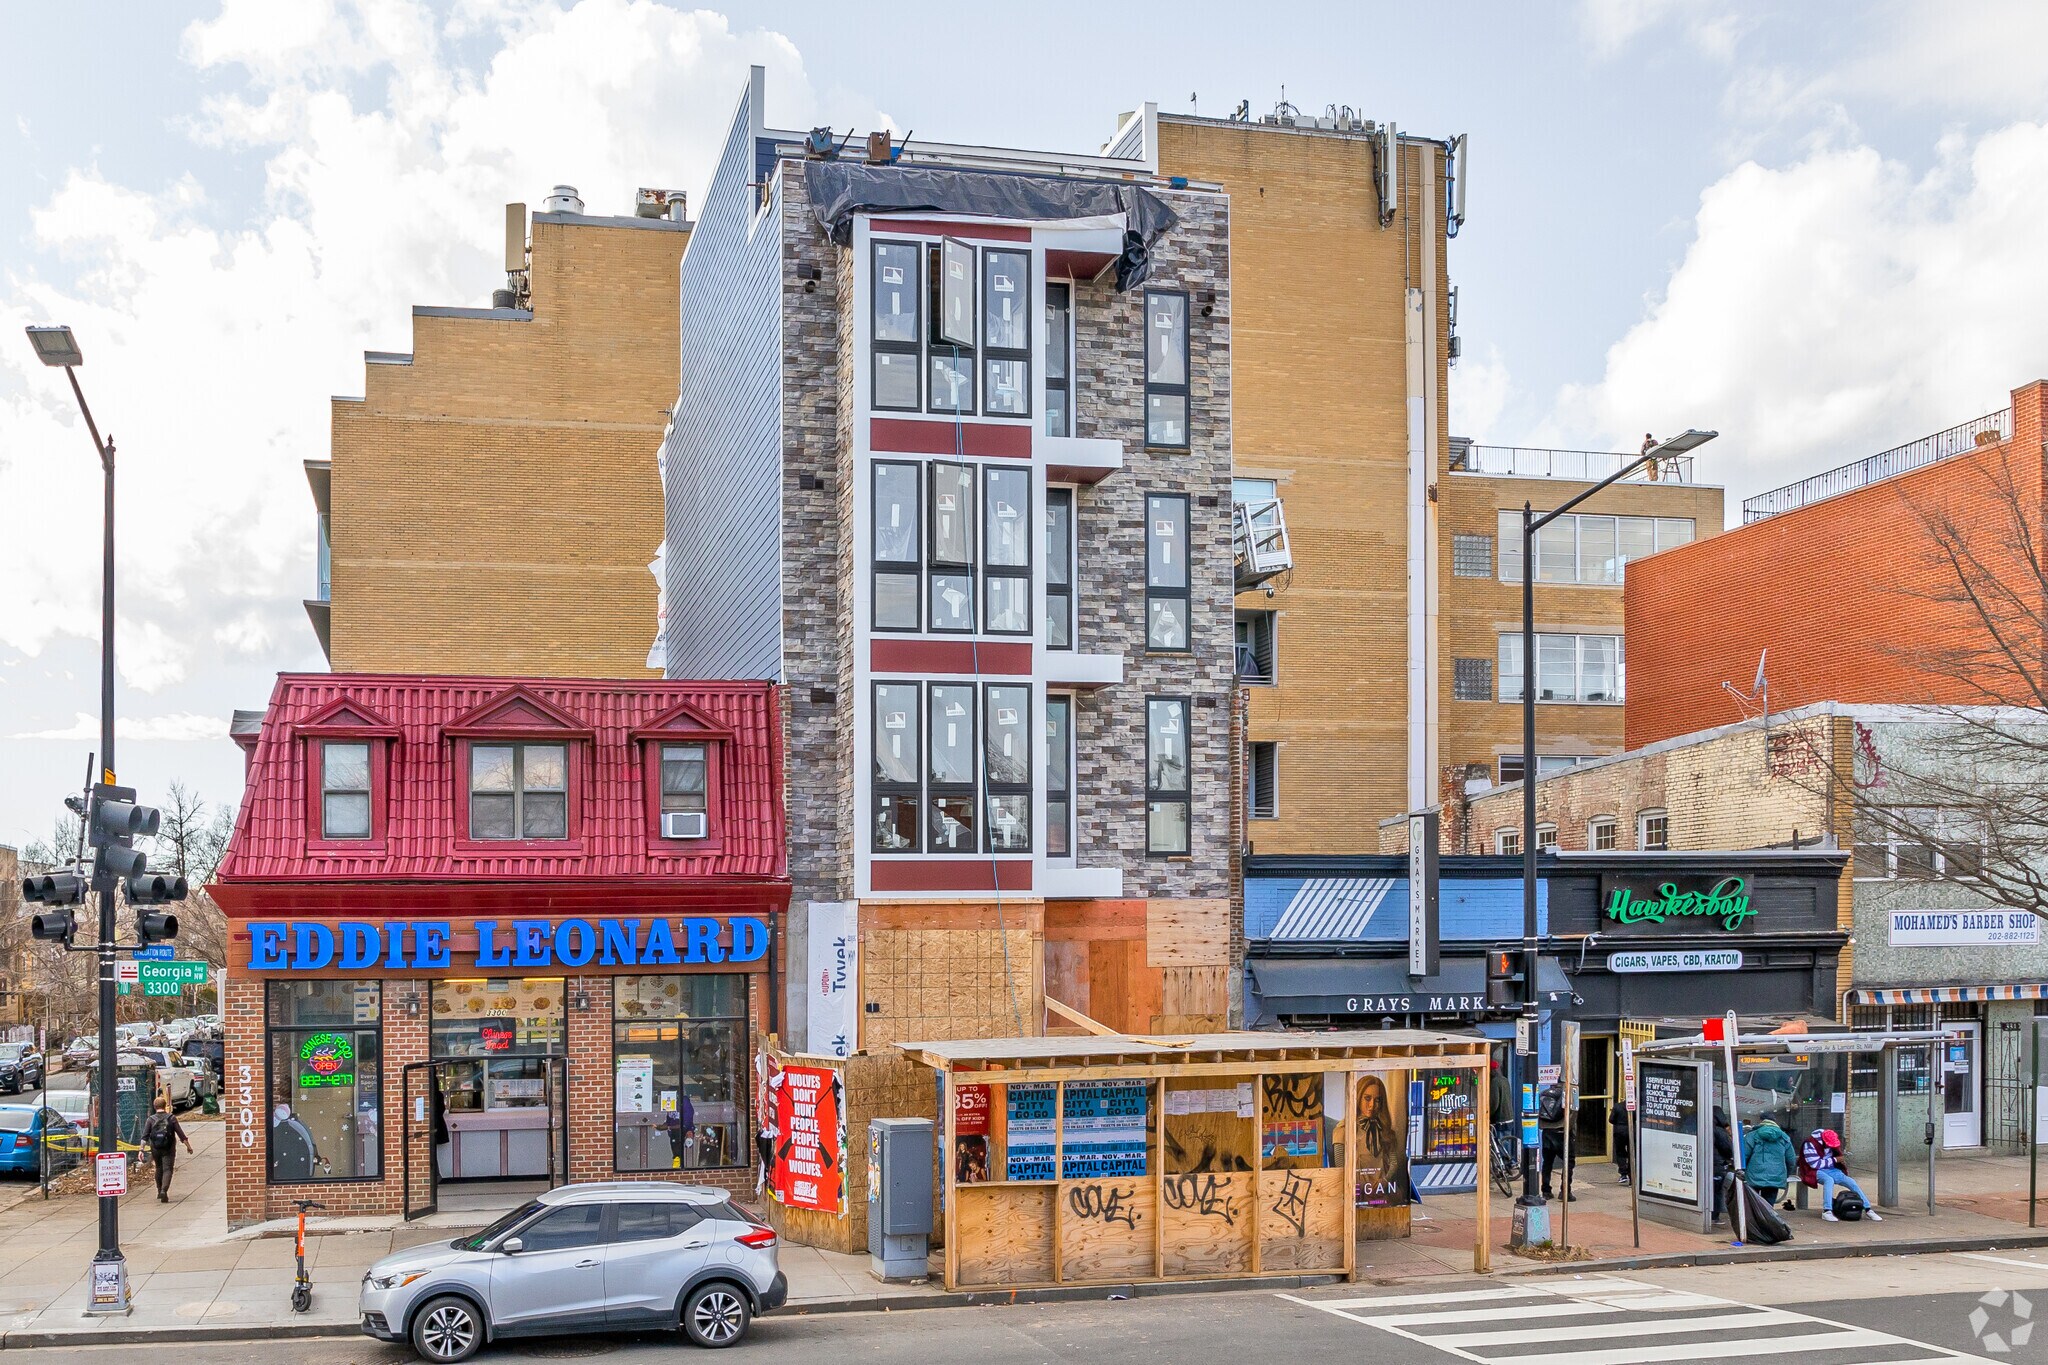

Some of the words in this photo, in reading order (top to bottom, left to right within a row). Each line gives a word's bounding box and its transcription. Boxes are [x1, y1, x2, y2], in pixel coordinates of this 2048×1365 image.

[1608, 876, 1758, 931] Hawkesbay
[1894, 914, 1958, 930] MOHAMED'S
[1962, 914, 2004, 930] BARBER
[247, 920, 450, 970] EDDIE
[474, 916, 770, 968] LEONARD
[1988, 932, 2035, 940] 202-882-1125
[160, 948, 172, 957] ROUTE
[1615, 956, 1648, 969] CIGARS,
[1651, 955, 1680, 967] VAPES,
[1683, 954, 1702, 967] CBD,
[1704, 954, 1738, 965] KRATOM
[142, 964, 192, 980] Georgia
[147, 982, 178, 994] 3300
[1346, 998, 1410, 1012] GRAYS
[1429, 996, 1494, 1010] MARK
[482, 1028, 512, 1039] Chinese
[301, 1034, 332, 1058] CHINESE
[334, 1036, 353, 1058] FOOD
[485, 1039, 509, 1050] Food
[301, 1075, 353, 1086] 882-4277
[788, 1073, 820, 1089] WOLVES
[1436, 1077, 1456, 1085] ATM
[793, 1088, 816, 1103] DON'T
[1009, 1090, 1054, 1101] CAPITAL
[1063, 1089, 1099, 1100] APITAL
[1101, 1087, 1144, 1098] CAPITAL
[238, 1066, 254, 1147] 3300
[794, 1102, 816, 1117] HUNT
[790, 1116, 820, 1133] PEOPLE.
[791, 1131, 819, 1147] PEOPLE
[795, 1146, 816, 1161] HUNT
[1672, 1143, 1692, 1151] HUNGER
[789, 1160, 823, 1177] WOLVES.
[1010, 1163, 1054, 1174] CAPITAL
[1063, 1161, 1099, 1172] APITAL
[1101, 1160, 1145, 1171] CAPITAL
